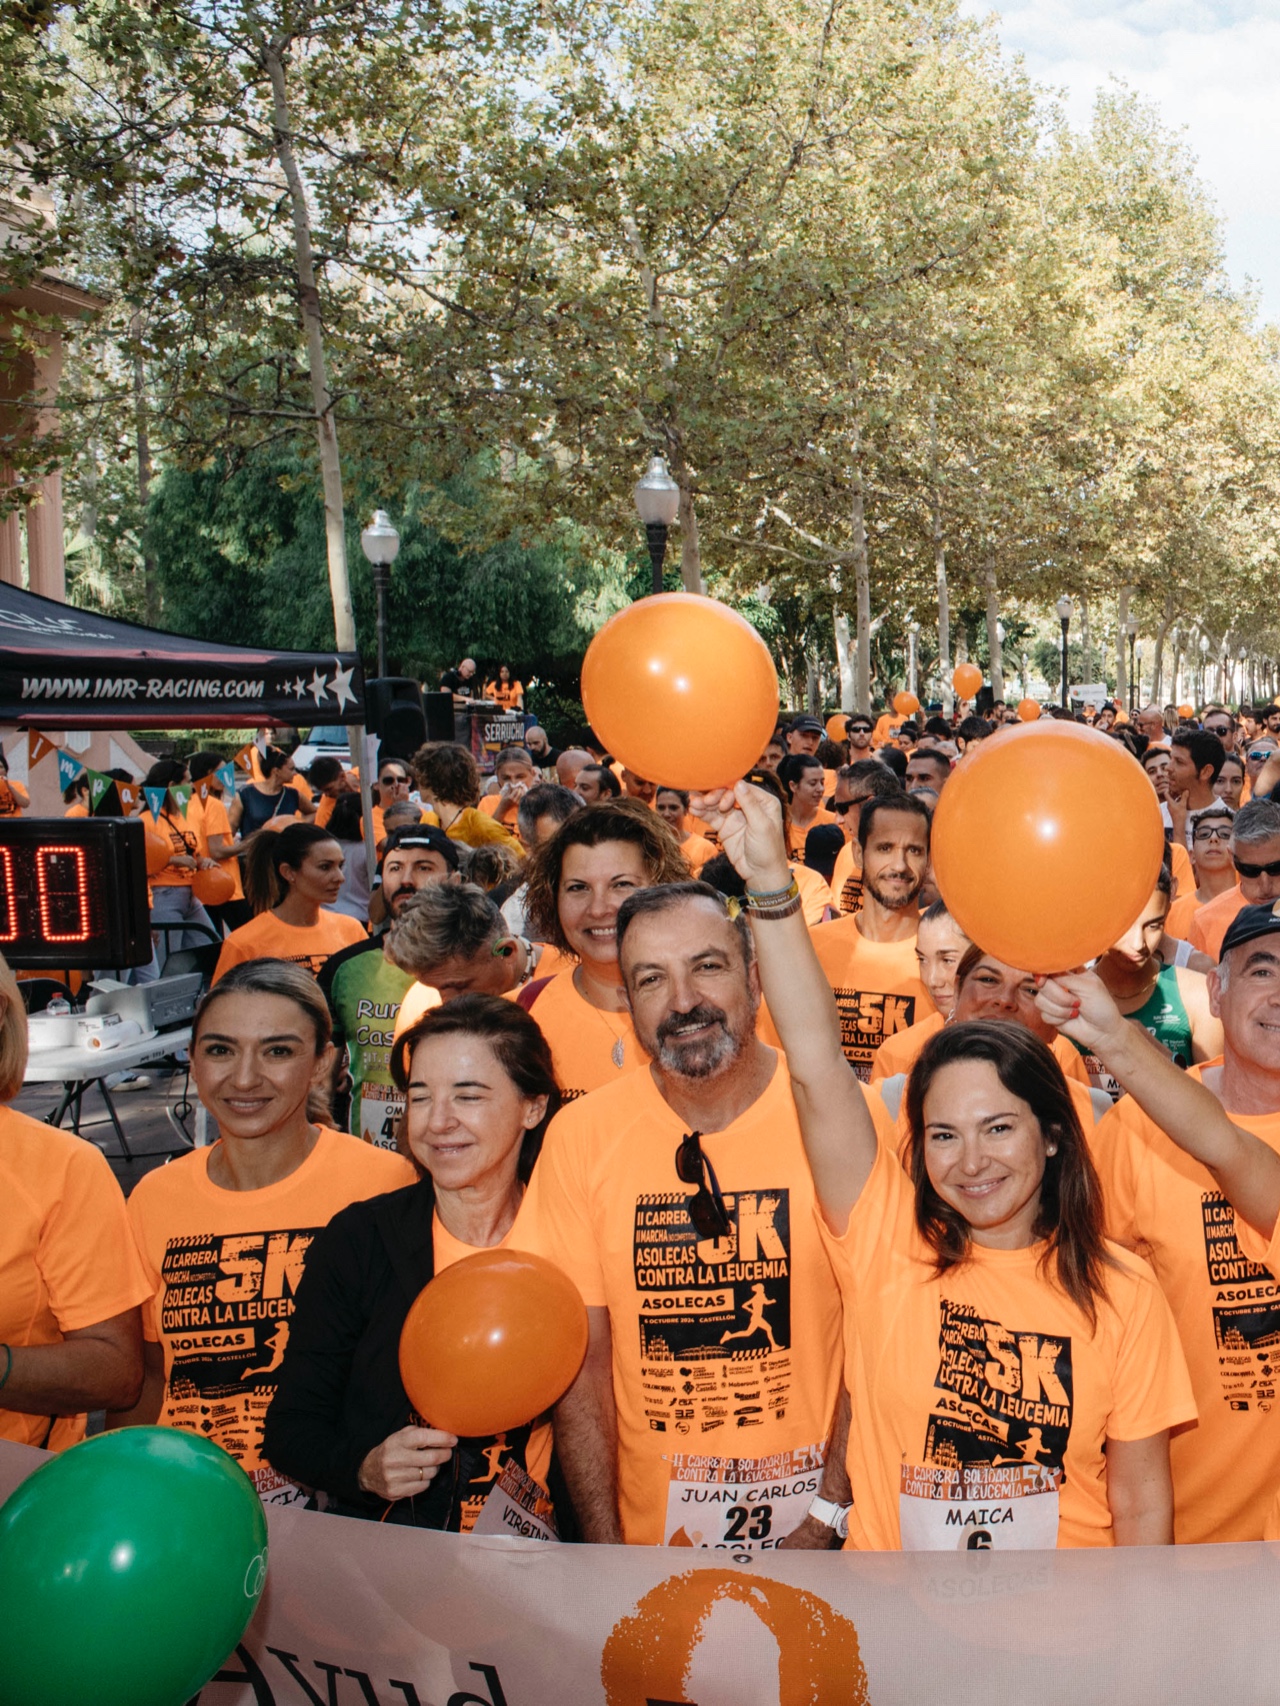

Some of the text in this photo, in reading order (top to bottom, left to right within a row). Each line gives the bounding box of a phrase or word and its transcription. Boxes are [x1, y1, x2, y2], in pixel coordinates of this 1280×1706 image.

[21, 677, 265, 700] WWW.IMR-RACING.COM
[485, 722, 525, 742] SERRUCHO
[858, 993, 911, 1035] 5K
[858, 1034, 868, 1045] LA
[637, 1212, 644, 1226] II
[1204, 1208, 1211, 1222] II
[641, 1228, 668, 1243] MARCHA
[172, 1250, 218, 1268] CARRERA
[636, 1246, 696, 1267] ASOLECAS
[215, 1233, 315, 1303] 5K
[637, 1260, 788, 1287] CONTRA LA LEUCEMIA
[1211, 1260, 1264, 1281] CONTRA
[164, 1285, 213, 1308] ASOLECAS
[642, 1295, 726, 1309] ASOLECAS
[163, 1306, 211, 1328] CONTRA
[215, 1304, 234, 1324] LA
[649, 1316, 679, 1325] OCTUBRE
[680, 1316, 695, 1324] 2024
[1224, 1308, 1251, 1317] OCTUBRE
[984, 1322, 1070, 1408] 5K
[981, 1385, 996, 1410] LA
[1000, 1394, 1070, 1428] LEUCEMIA
[687, 1454, 734, 1469] CARRERA
[738, 1451, 790, 1470] SOLIDARIA
[677, 1464, 792, 1483] CONTRA LA LEUCEMIA
[914, 1465, 959, 1484] CARRERA
[963, 1465, 1020, 1484] SOLIDARIA
[1022, 1464, 1060, 1494] 5K
[681, 1478, 817, 1502] JUAN CARLOS
[905, 1479, 1022, 1500] CONTRA LA LEUCEMIA
[723, 1505, 773, 1541] 23
[945, 1507, 1014, 1526] MAICA
